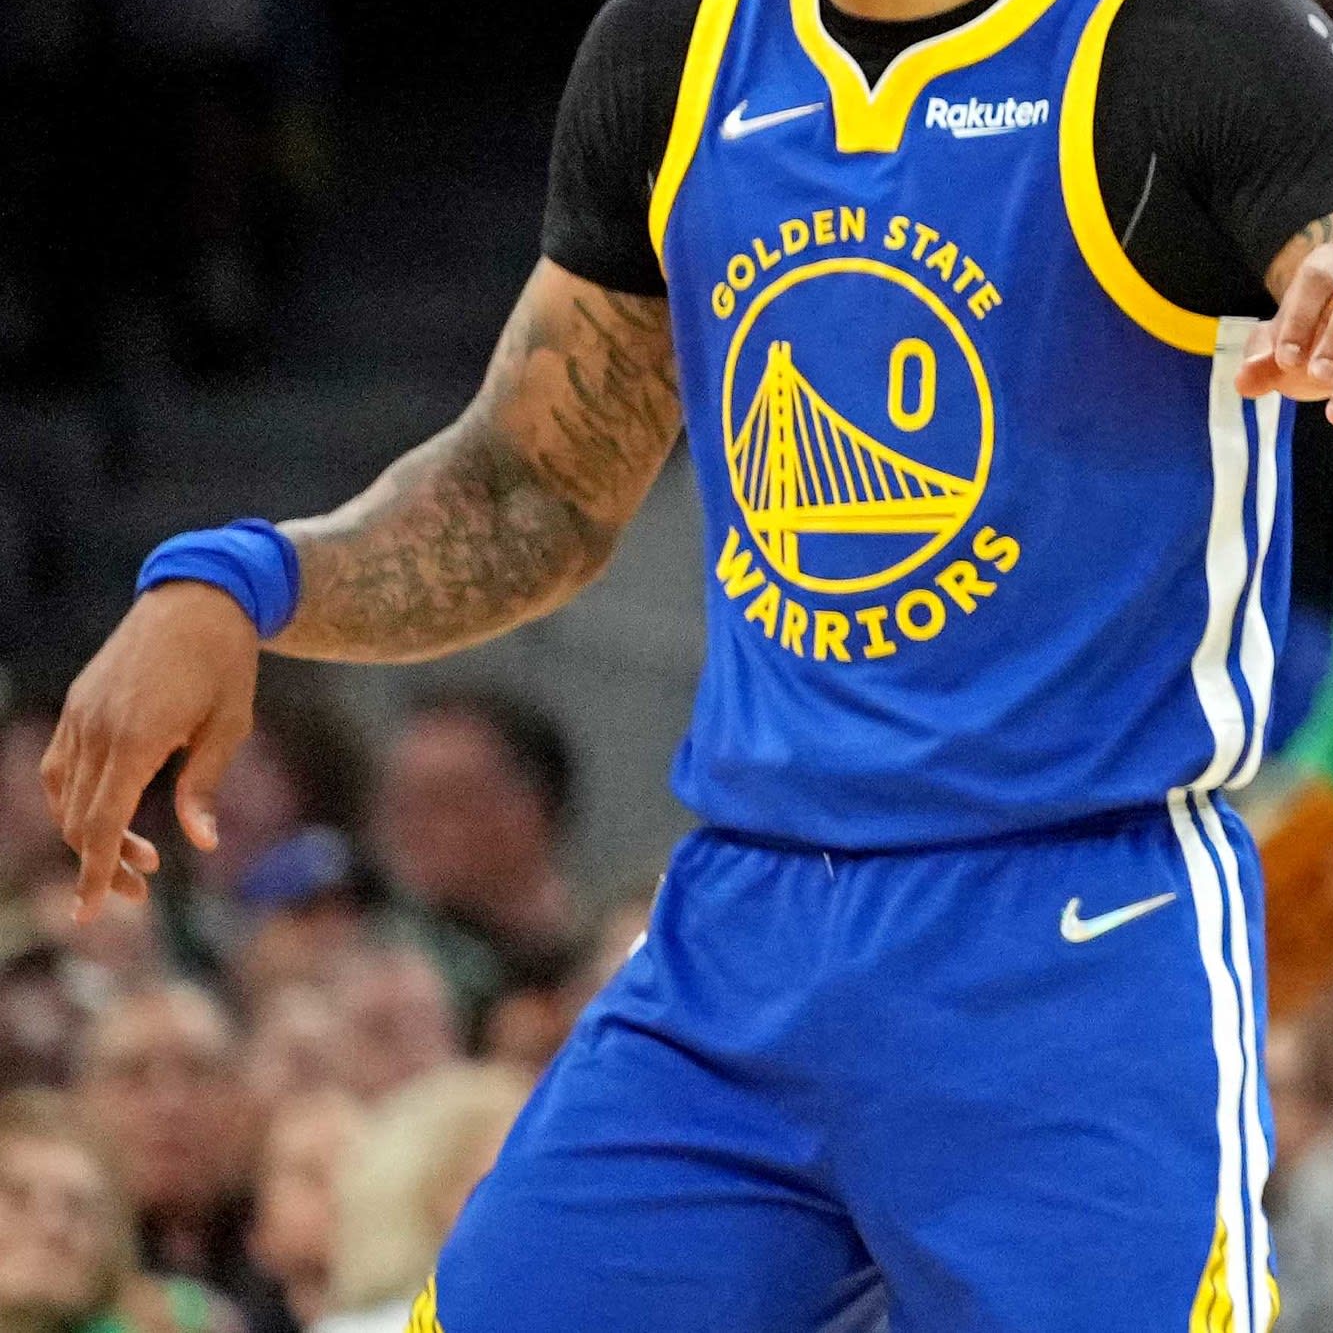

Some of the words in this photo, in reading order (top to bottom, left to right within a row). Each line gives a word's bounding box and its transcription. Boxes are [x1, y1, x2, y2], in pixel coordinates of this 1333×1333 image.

[925, 97, 1049, 139] Rakuten
[711, 206, 867, 319] GOLDEN
[883, 215, 1002, 320] STATE
[888, 337, 937, 433] 0
[714, 526, 1022, 662] WARRIORS
